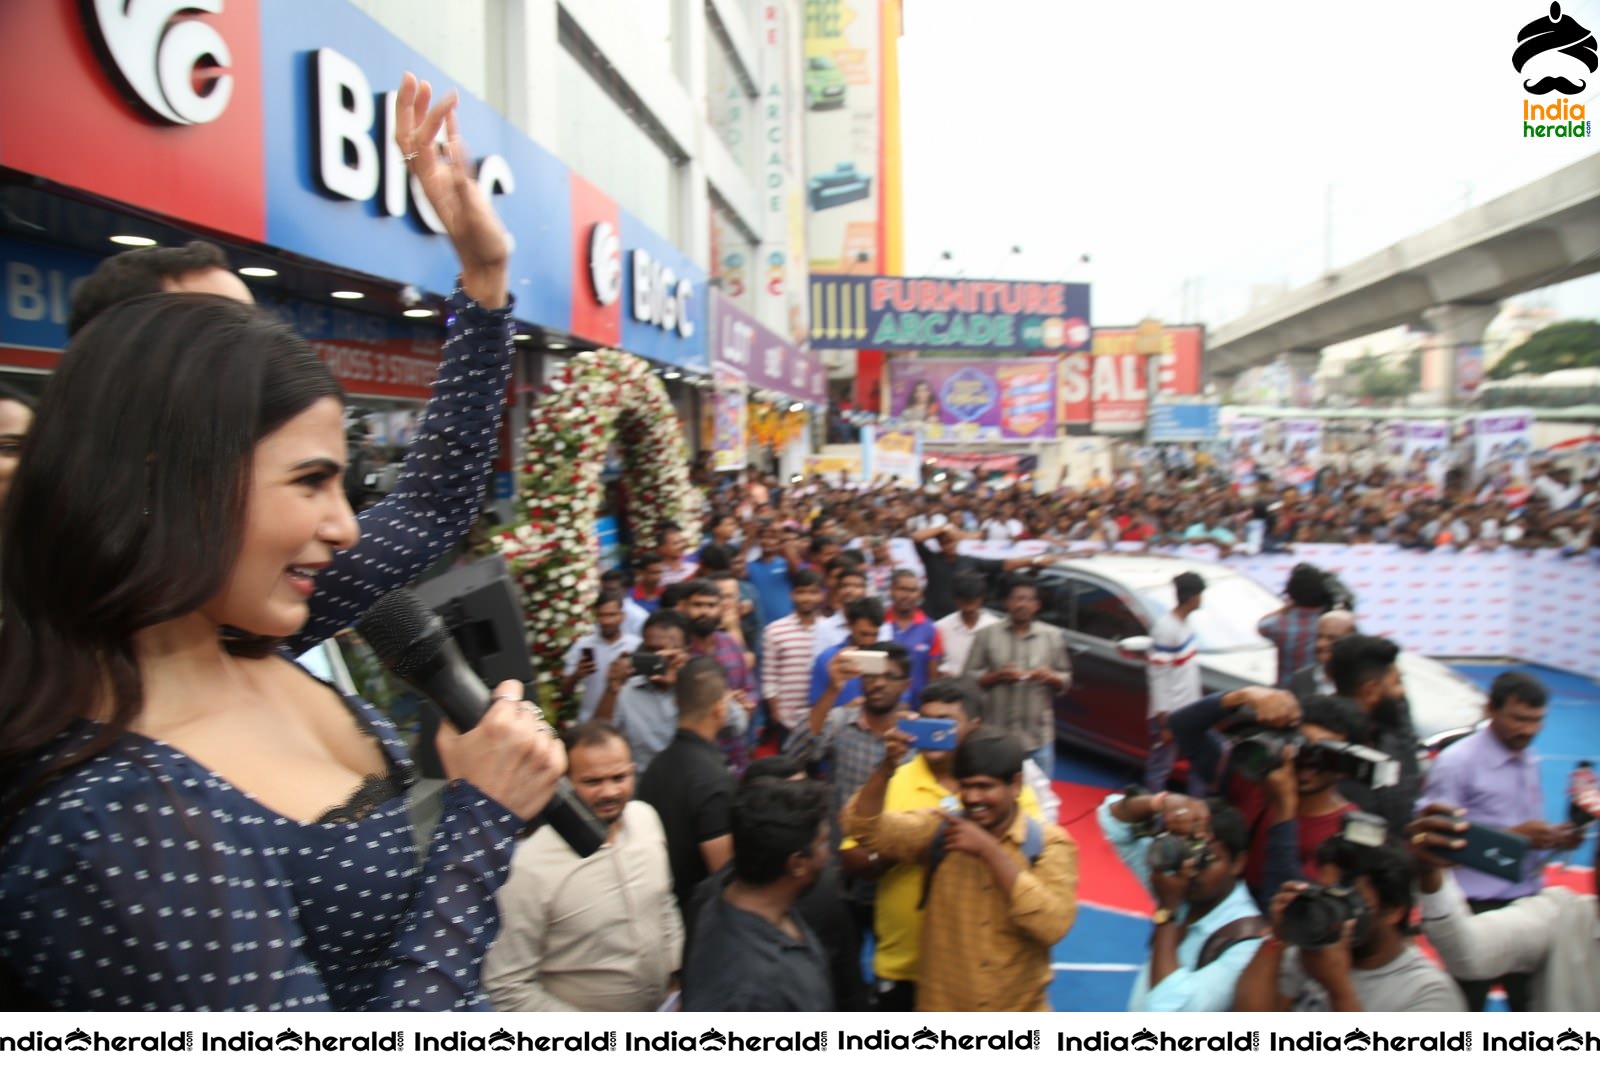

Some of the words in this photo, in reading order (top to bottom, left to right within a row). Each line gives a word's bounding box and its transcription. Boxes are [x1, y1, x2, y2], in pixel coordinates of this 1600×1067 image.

[766, 82, 786, 213] ARCADE
[632, 247, 676, 331] BIG
[676, 277, 694, 338] C
[870, 278, 1067, 315] FURNITURE
[871, 312, 1016, 346] ARCADE
[1063, 352, 1177, 404] SALE
